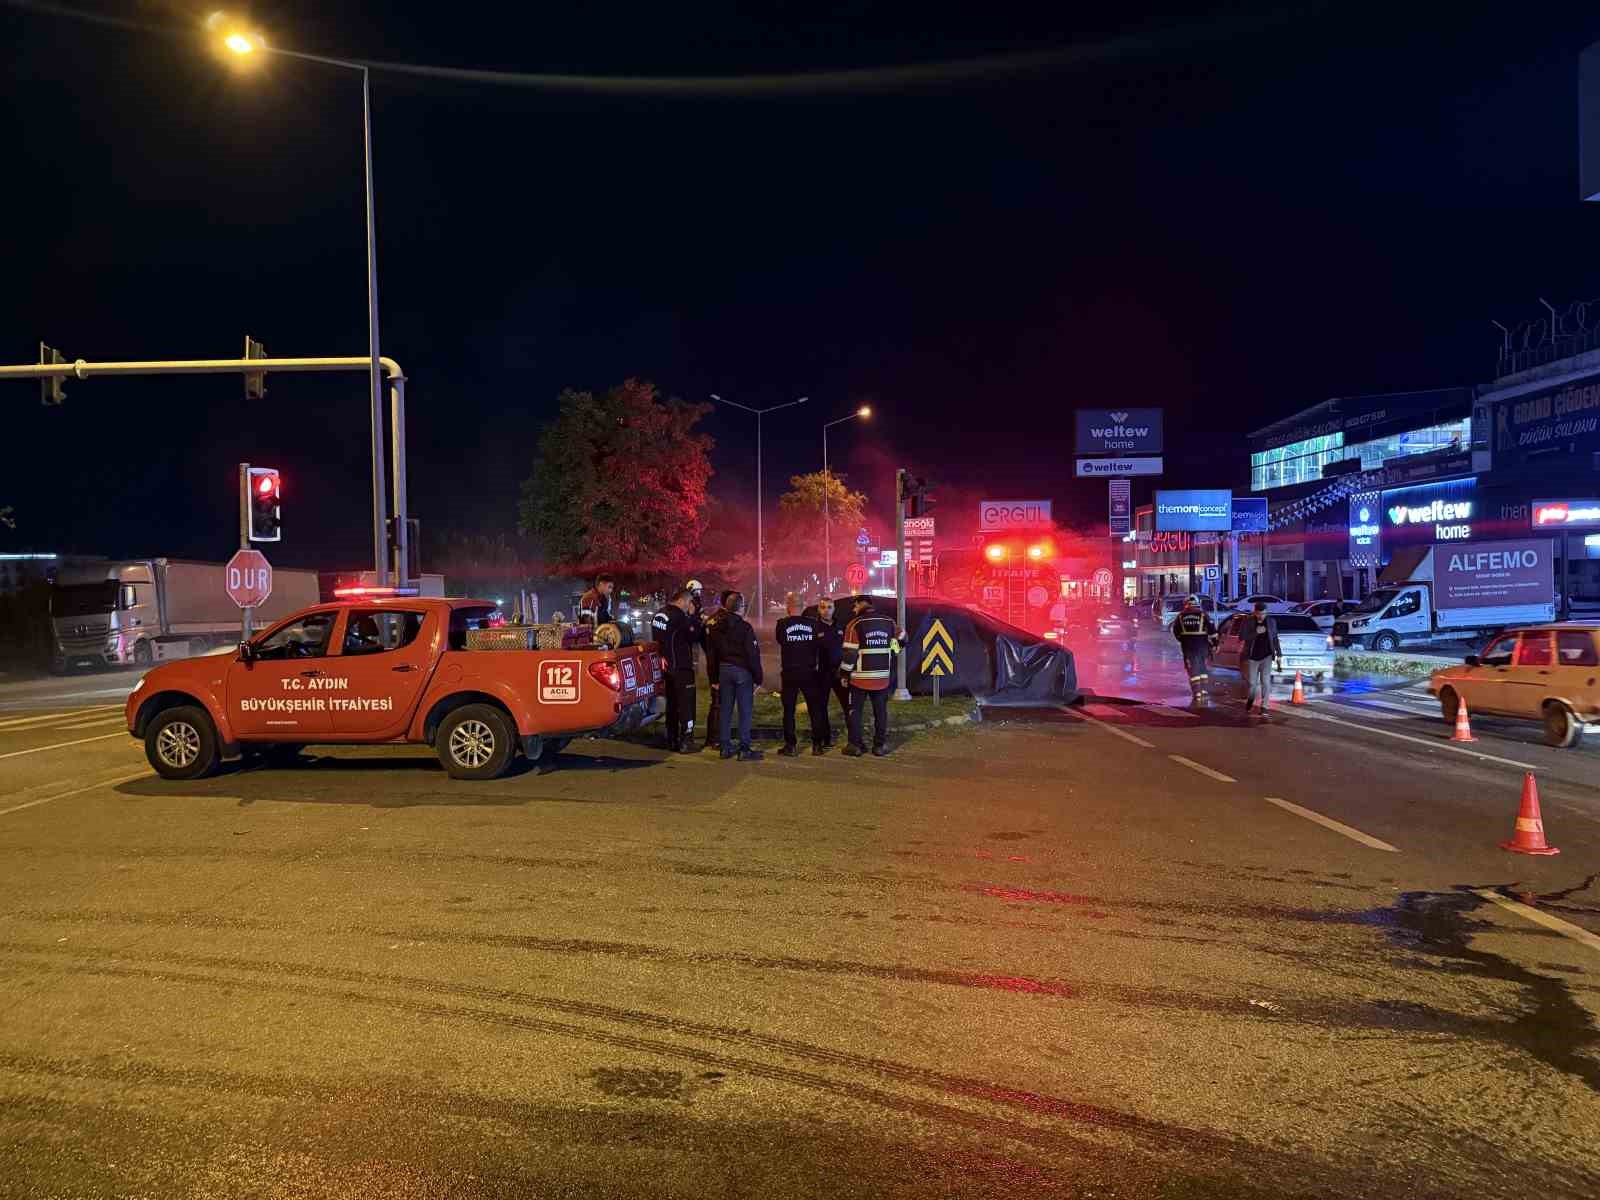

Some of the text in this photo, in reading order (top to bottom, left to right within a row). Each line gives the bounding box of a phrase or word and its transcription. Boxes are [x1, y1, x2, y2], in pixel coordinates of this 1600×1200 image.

[1090, 425, 1149, 437] weltew
[1104, 439, 1135, 449] home
[1094, 463, 1133, 472] weltew
[1408, 501, 1472, 523] weltew
[1436, 525, 1471, 539] home
[1448, 550, 1538, 572] ALFEMO
[230, 568, 267, 590] DUR
[848, 567, 864, 583] 70
[1098, 573, 1110, 583] 70
[1208, 568, 1217, 577] D
[546, 667, 573, 685] 112
[281, 678, 348, 690] T.C. AYDIN
[241, 697, 393, 713] BÜYÜKŞEHİR İTFAİYESİ
